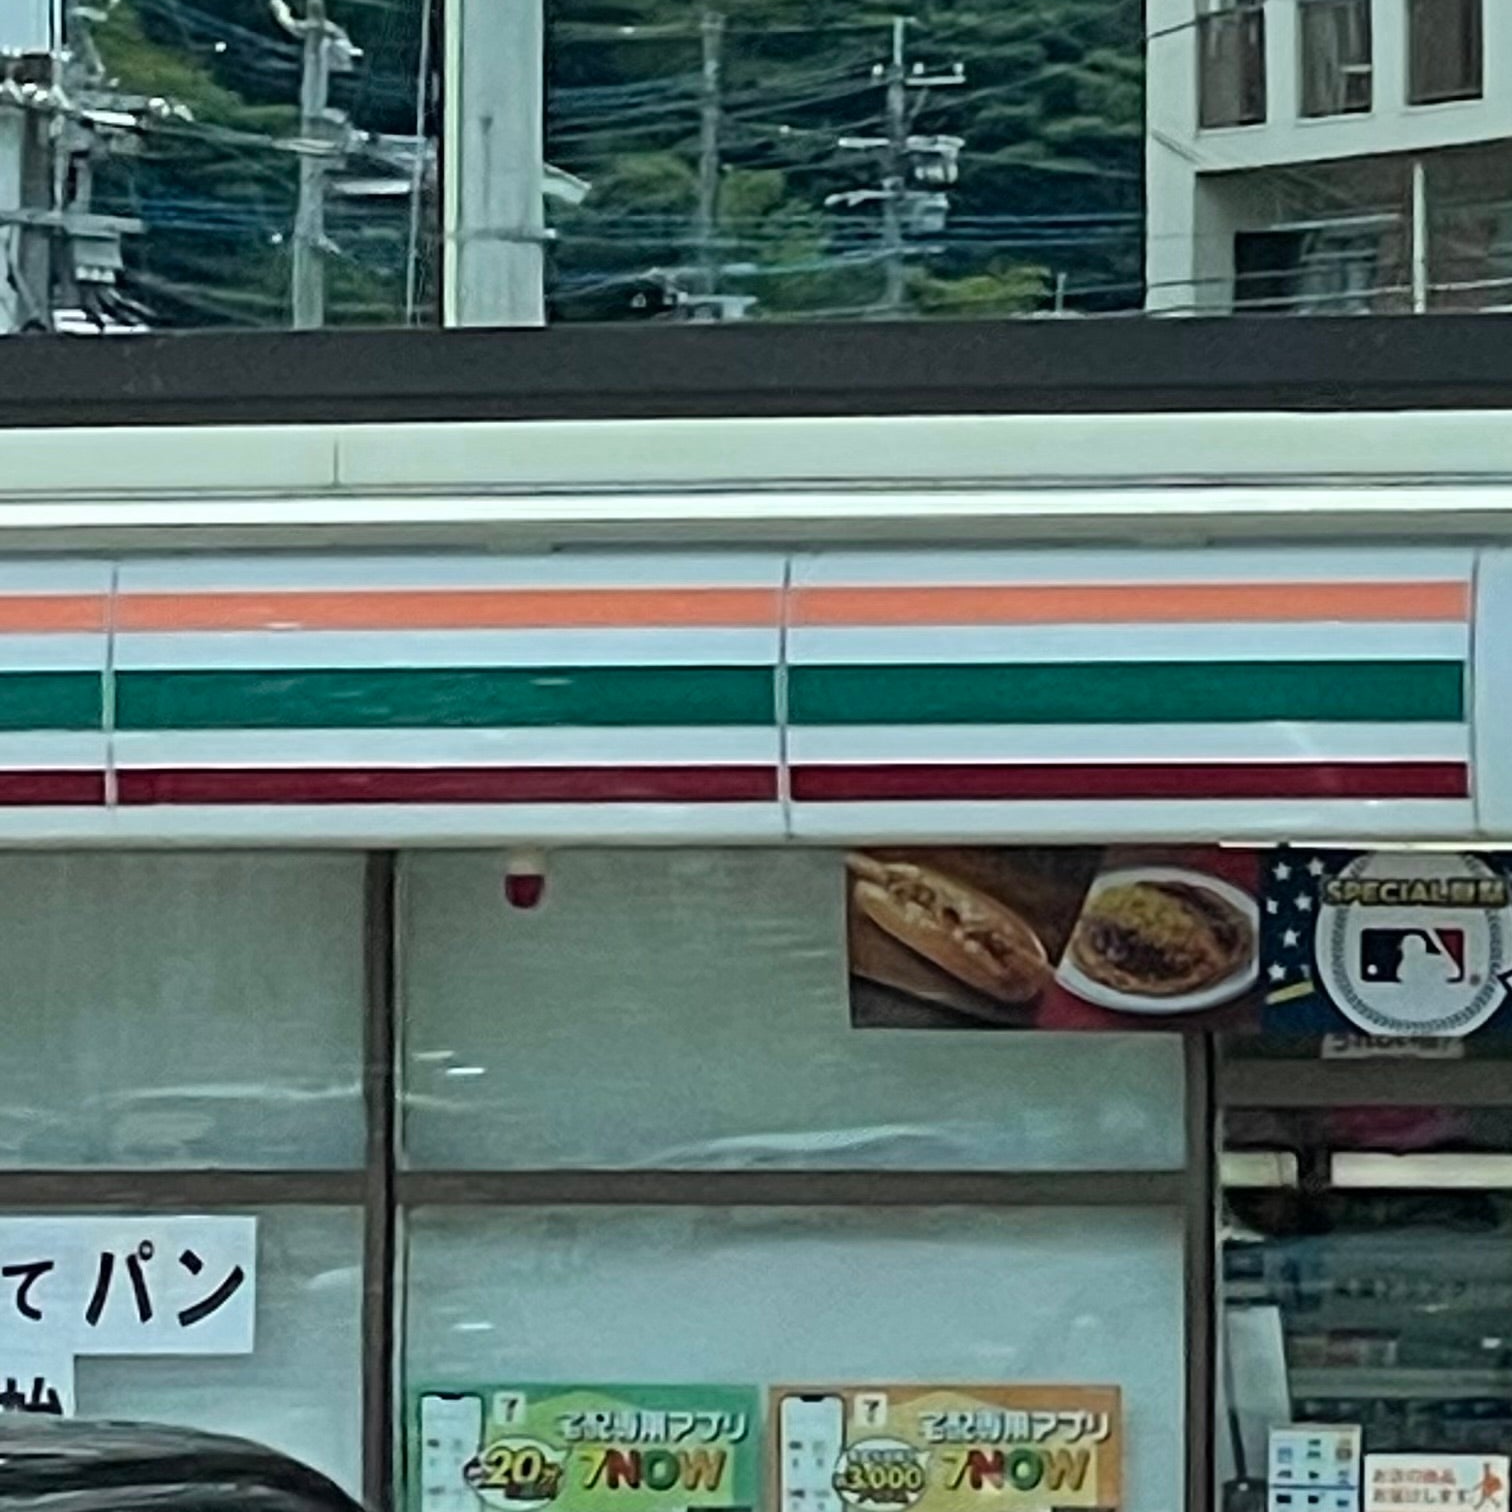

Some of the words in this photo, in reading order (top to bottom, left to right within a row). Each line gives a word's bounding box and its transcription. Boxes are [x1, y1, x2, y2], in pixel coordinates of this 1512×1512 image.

[2, 1240, 244, 1326] てパン
[580, 1445, 728, 1491] 7NOW
[941, 1448, 1091, 1491] 7NOW
